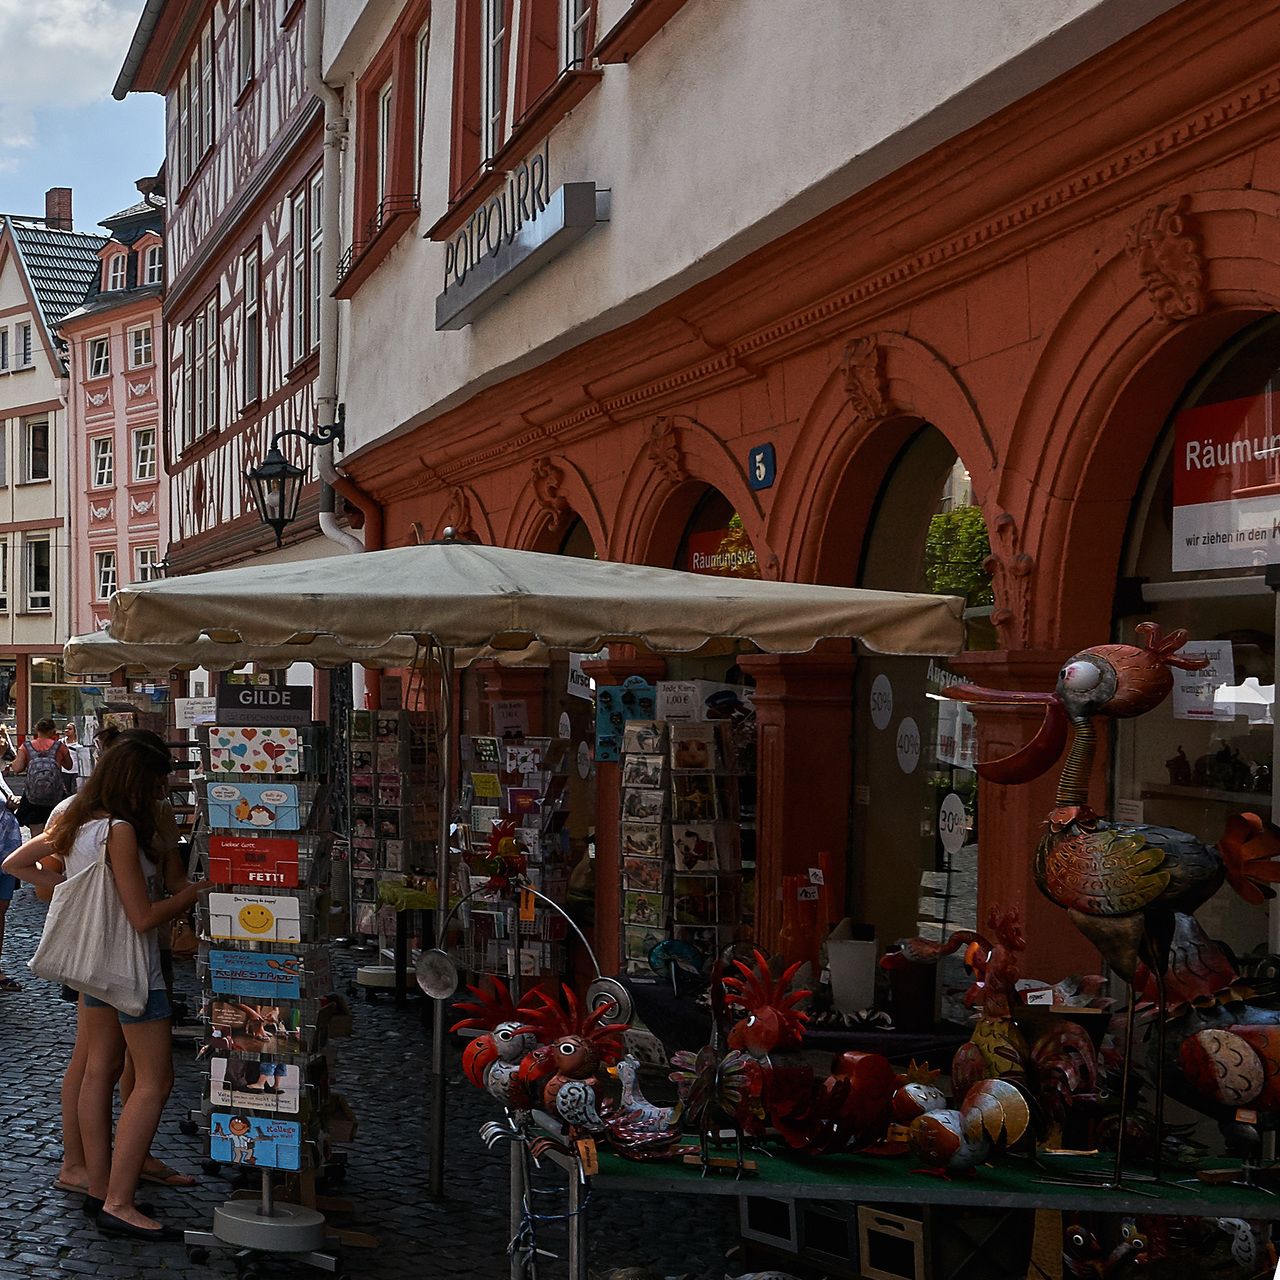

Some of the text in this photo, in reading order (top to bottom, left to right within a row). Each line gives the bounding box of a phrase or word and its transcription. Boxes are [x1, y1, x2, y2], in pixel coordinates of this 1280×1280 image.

[755, 452, 766, 481] 5
[1185, 534, 1200, 547] wir
[1202, 530, 1234, 546] ziehen
[1236, 528, 1245, 542] in
[1248, 526, 1268, 541] den
[238, 690, 292, 705] GILDE
[871, 690, 893, 713] 50%
[897, 732, 921, 756] 40%
[248, 872, 284, 883] FETT!
[266, 1125, 296, 1134] Kollege
